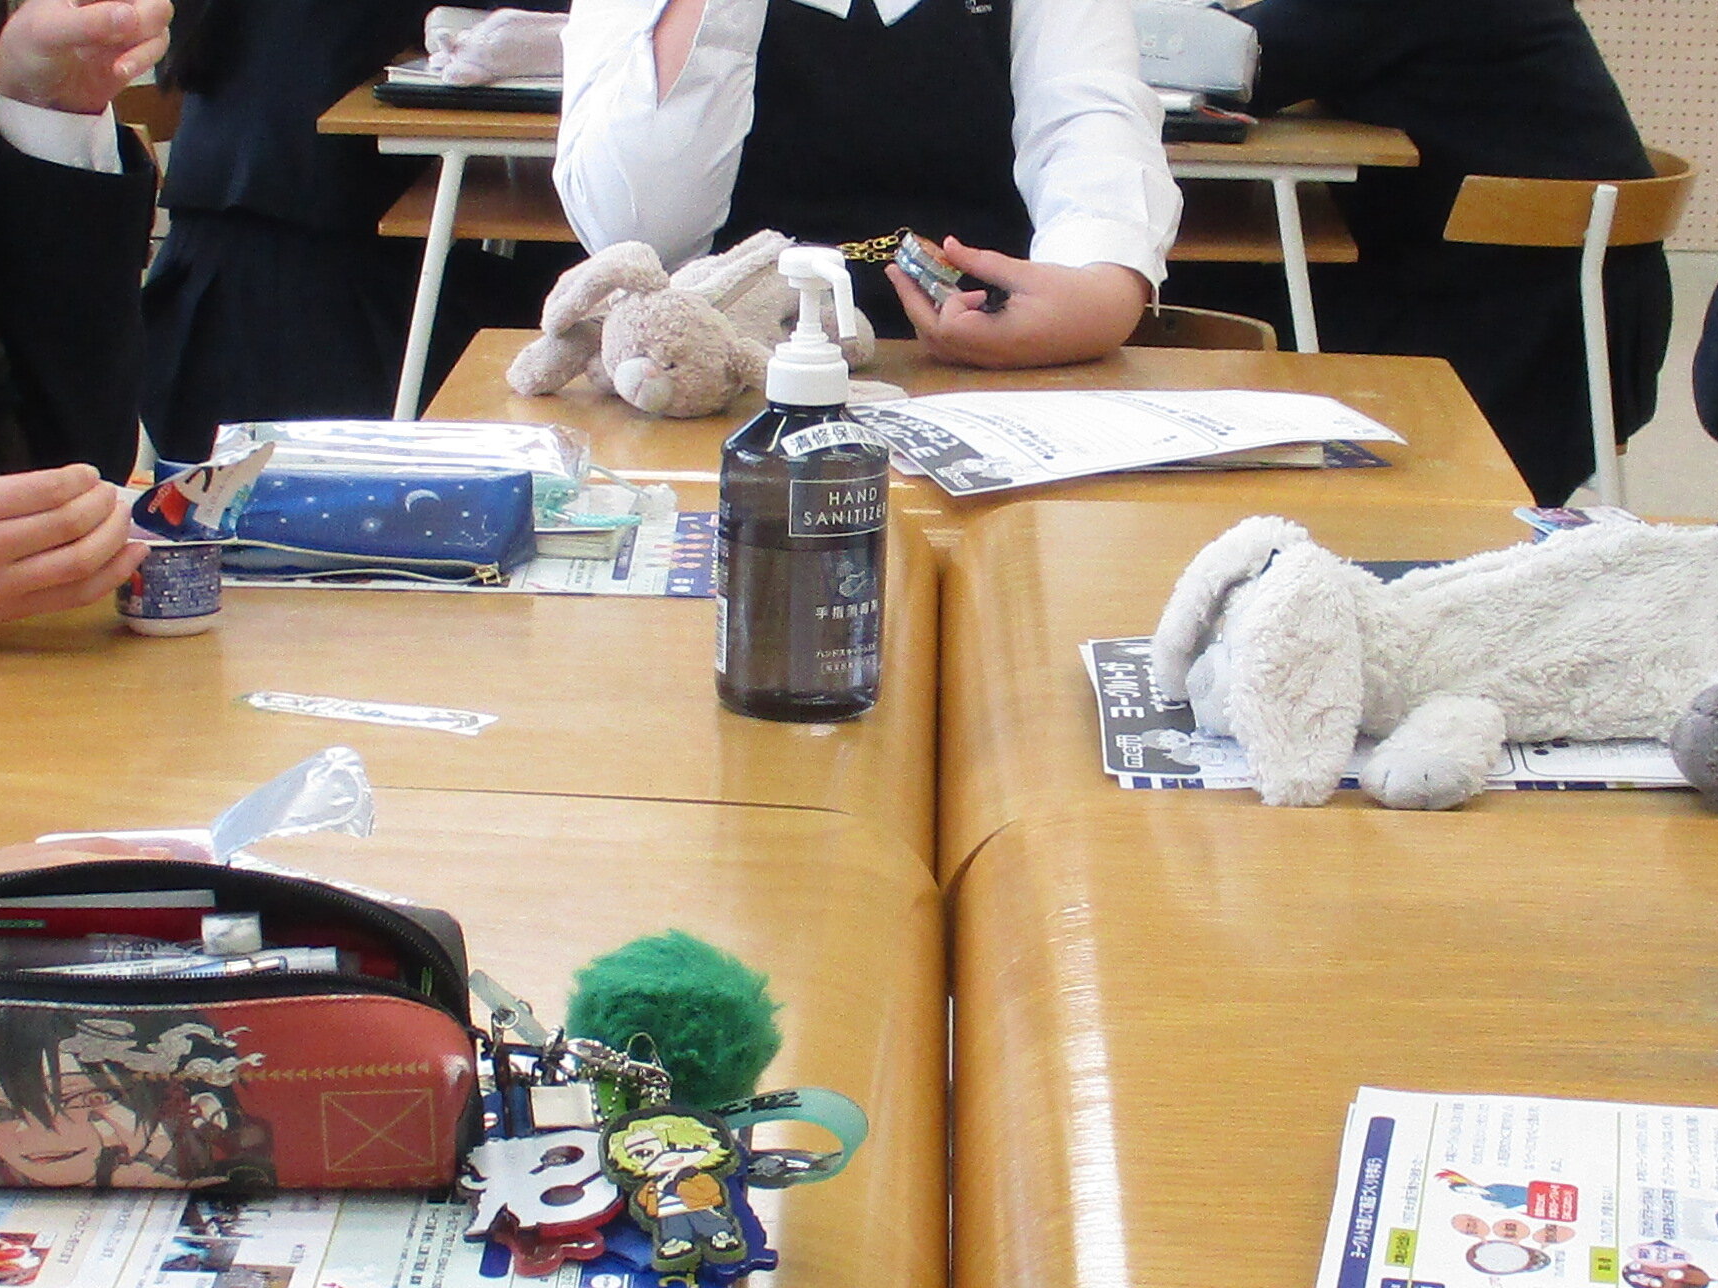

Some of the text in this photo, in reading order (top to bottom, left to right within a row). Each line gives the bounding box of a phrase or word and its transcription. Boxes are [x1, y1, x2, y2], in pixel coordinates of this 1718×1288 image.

[828, 486, 878, 506] HAND
[1099, 662, 1145, 718] ヨーグルトが
[1115, 734, 1144, 768] meiji
